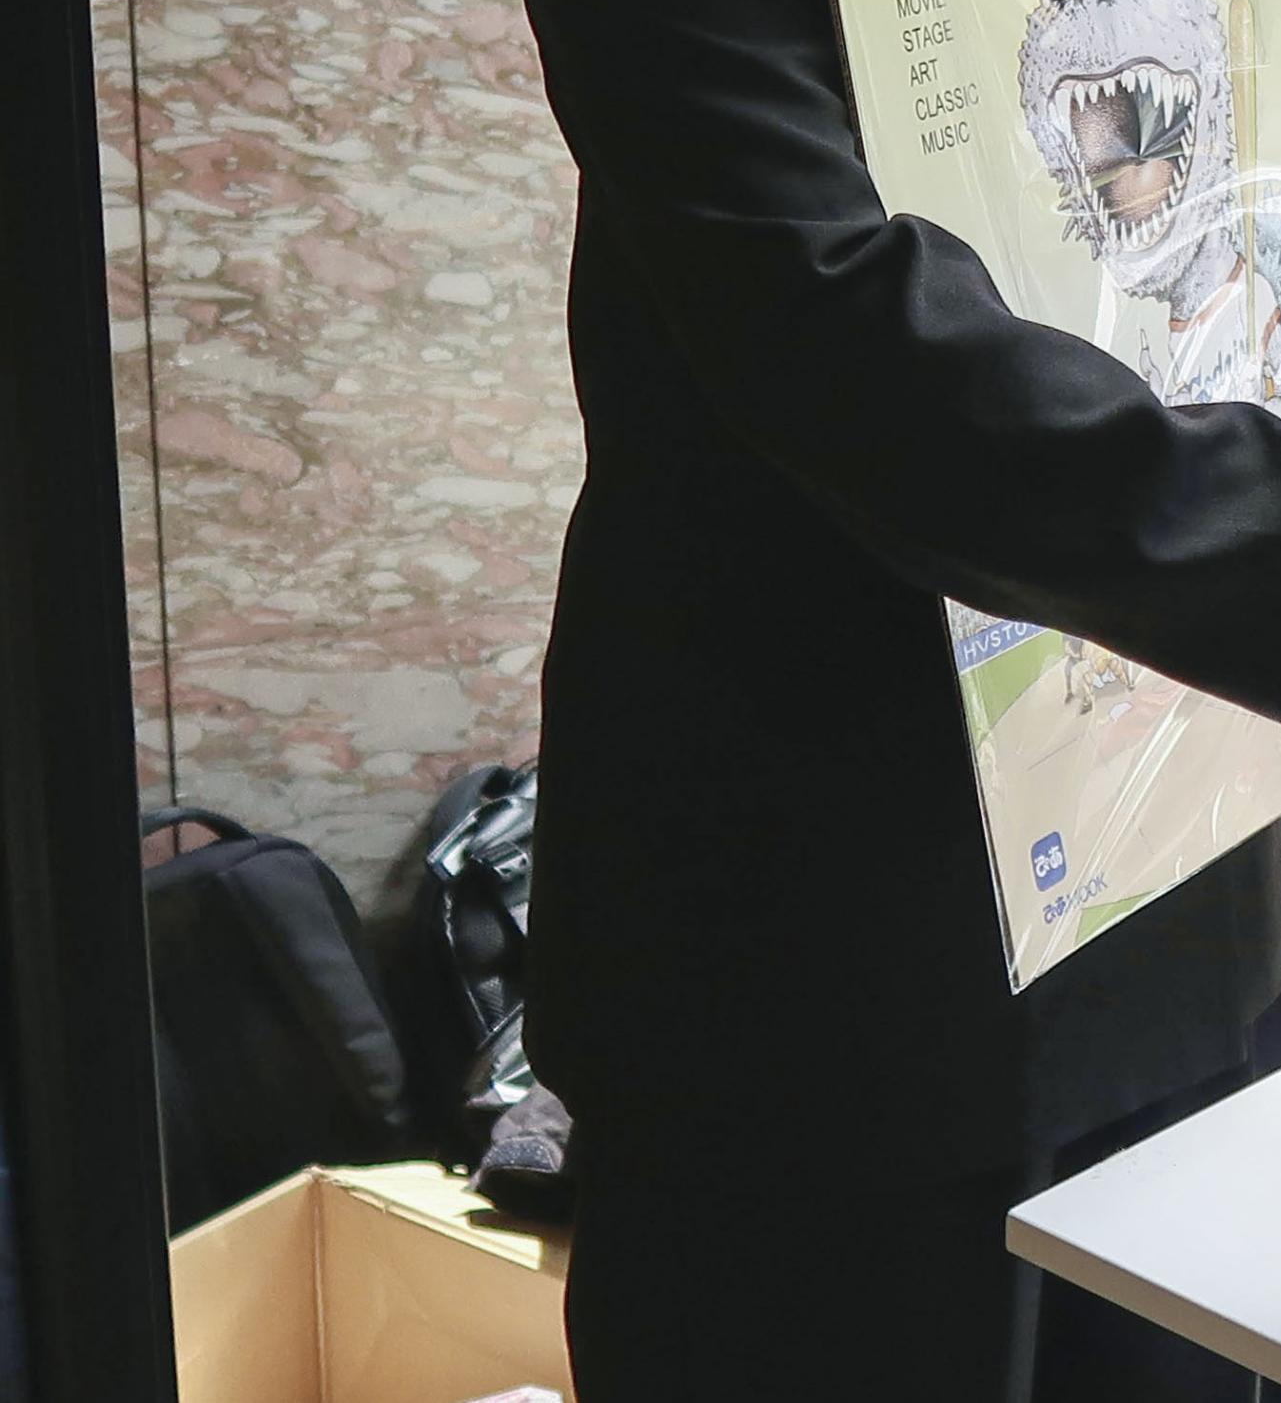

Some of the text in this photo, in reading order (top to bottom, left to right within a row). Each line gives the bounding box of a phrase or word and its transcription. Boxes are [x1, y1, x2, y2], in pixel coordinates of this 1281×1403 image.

[902, 19, 953, 53] STAGE
[910, 58, 939, 88] ART
[915, 83, 979, 121] CLASSIC
[921, 121, 971, 156] MUSIC
[1034, 845, 1064, 878] ぴあ
